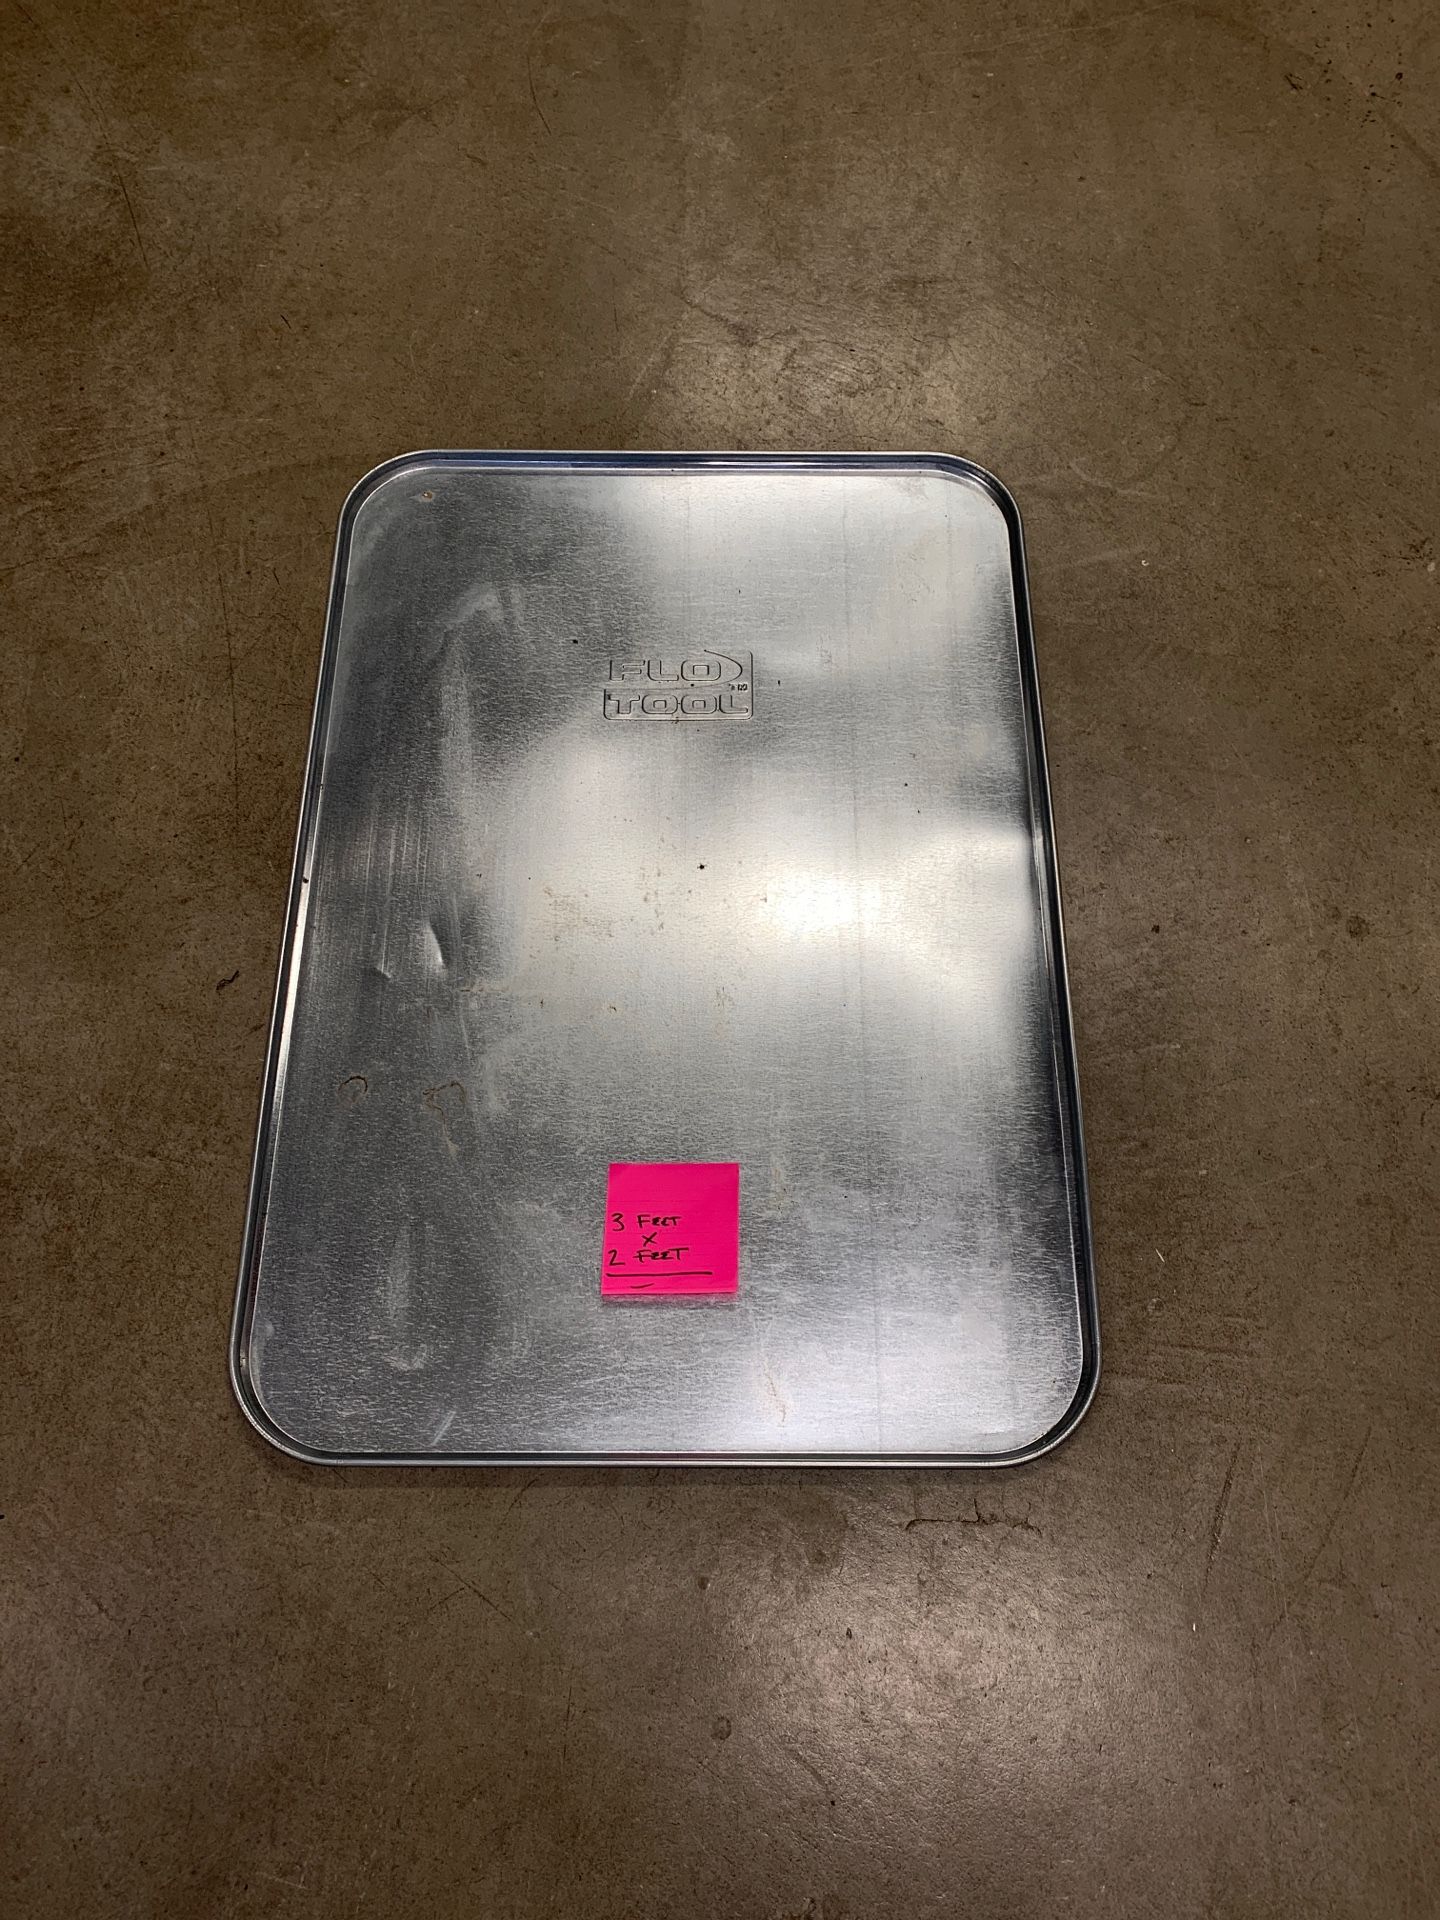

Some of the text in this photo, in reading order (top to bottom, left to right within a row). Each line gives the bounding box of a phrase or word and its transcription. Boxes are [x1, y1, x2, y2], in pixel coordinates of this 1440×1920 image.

[608, 657, 721, 682] FLO
[606, 691, 749, 715] TOOL
[611, 1212, 625, 1232] 3
[607, 1248, 626, 1266] 2
